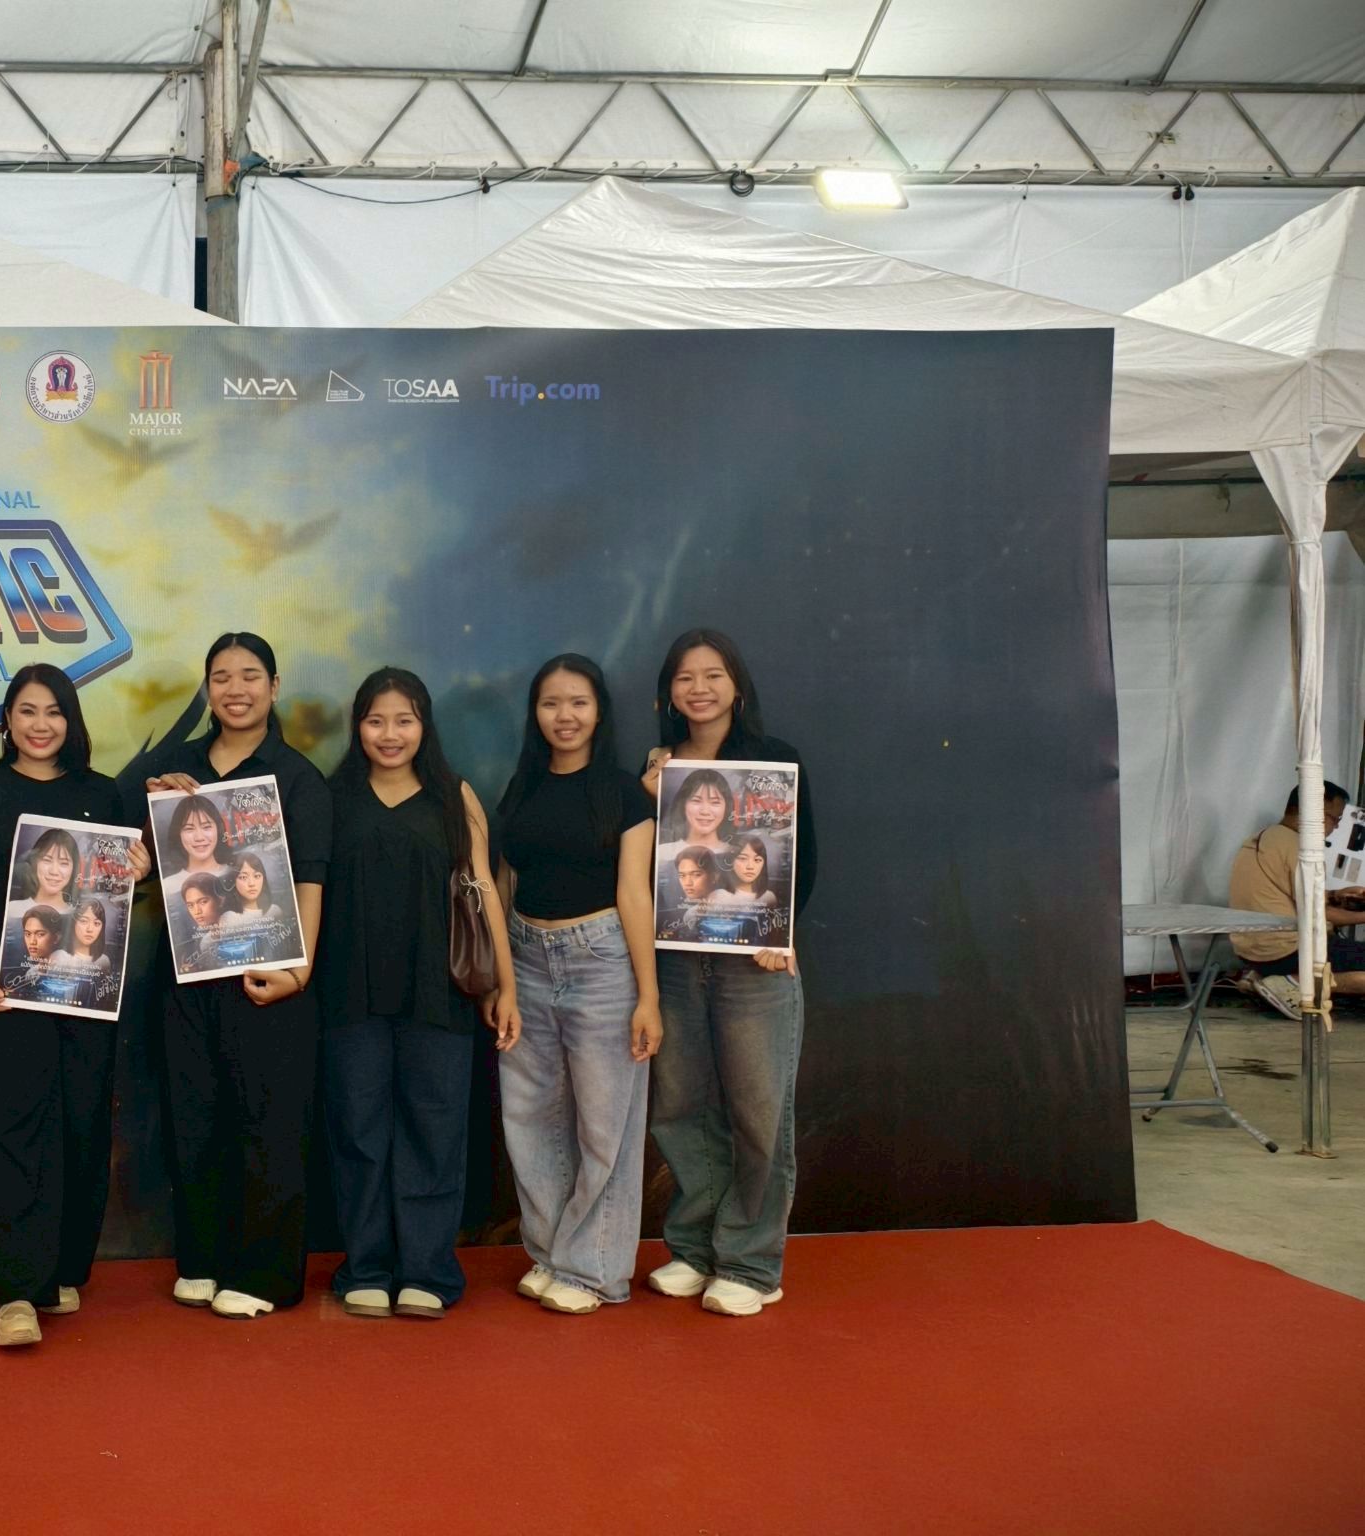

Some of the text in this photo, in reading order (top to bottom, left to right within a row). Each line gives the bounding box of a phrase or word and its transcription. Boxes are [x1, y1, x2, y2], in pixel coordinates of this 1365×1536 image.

[223, 377, 298, 396] NAPA
[383, 378, 460, 398] TOSAA
[484, 375, 601, 406] Trip.com
[129, 412, 182, 428] MAJOR
[129, 428, 183, 436] CINEPLEX
